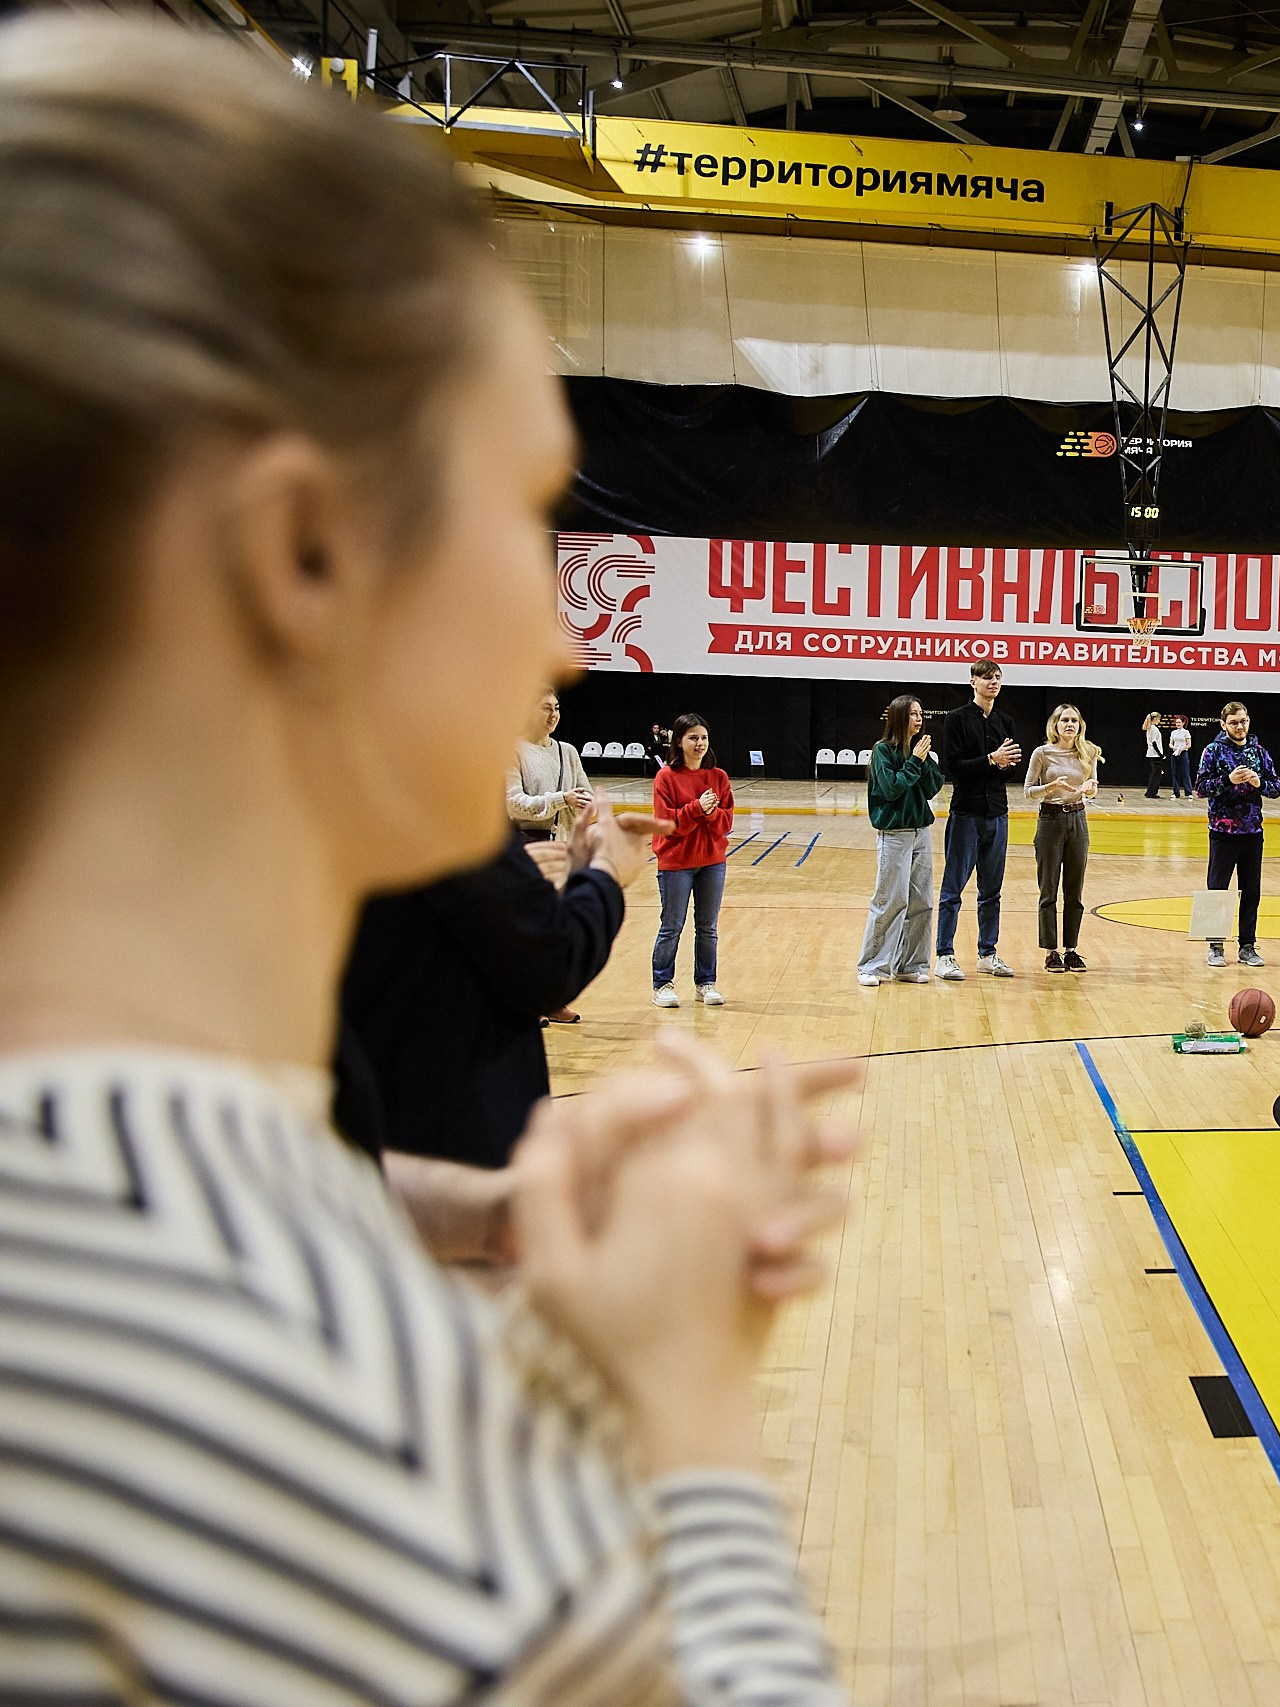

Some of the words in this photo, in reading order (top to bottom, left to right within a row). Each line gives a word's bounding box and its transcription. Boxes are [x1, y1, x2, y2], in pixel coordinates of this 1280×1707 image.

[633, 142, 1045, 203] #территориямяча
[708, 537, 1120, 626] ФЕСТИВАЛЬ
[734, 630, 793, 653] ДЛЯ
[802, 632, 1010, 659] СОТРУДНИКОВ
[1019, 640, 1249, 667] ПРАВИТЕЛЬСТВА
